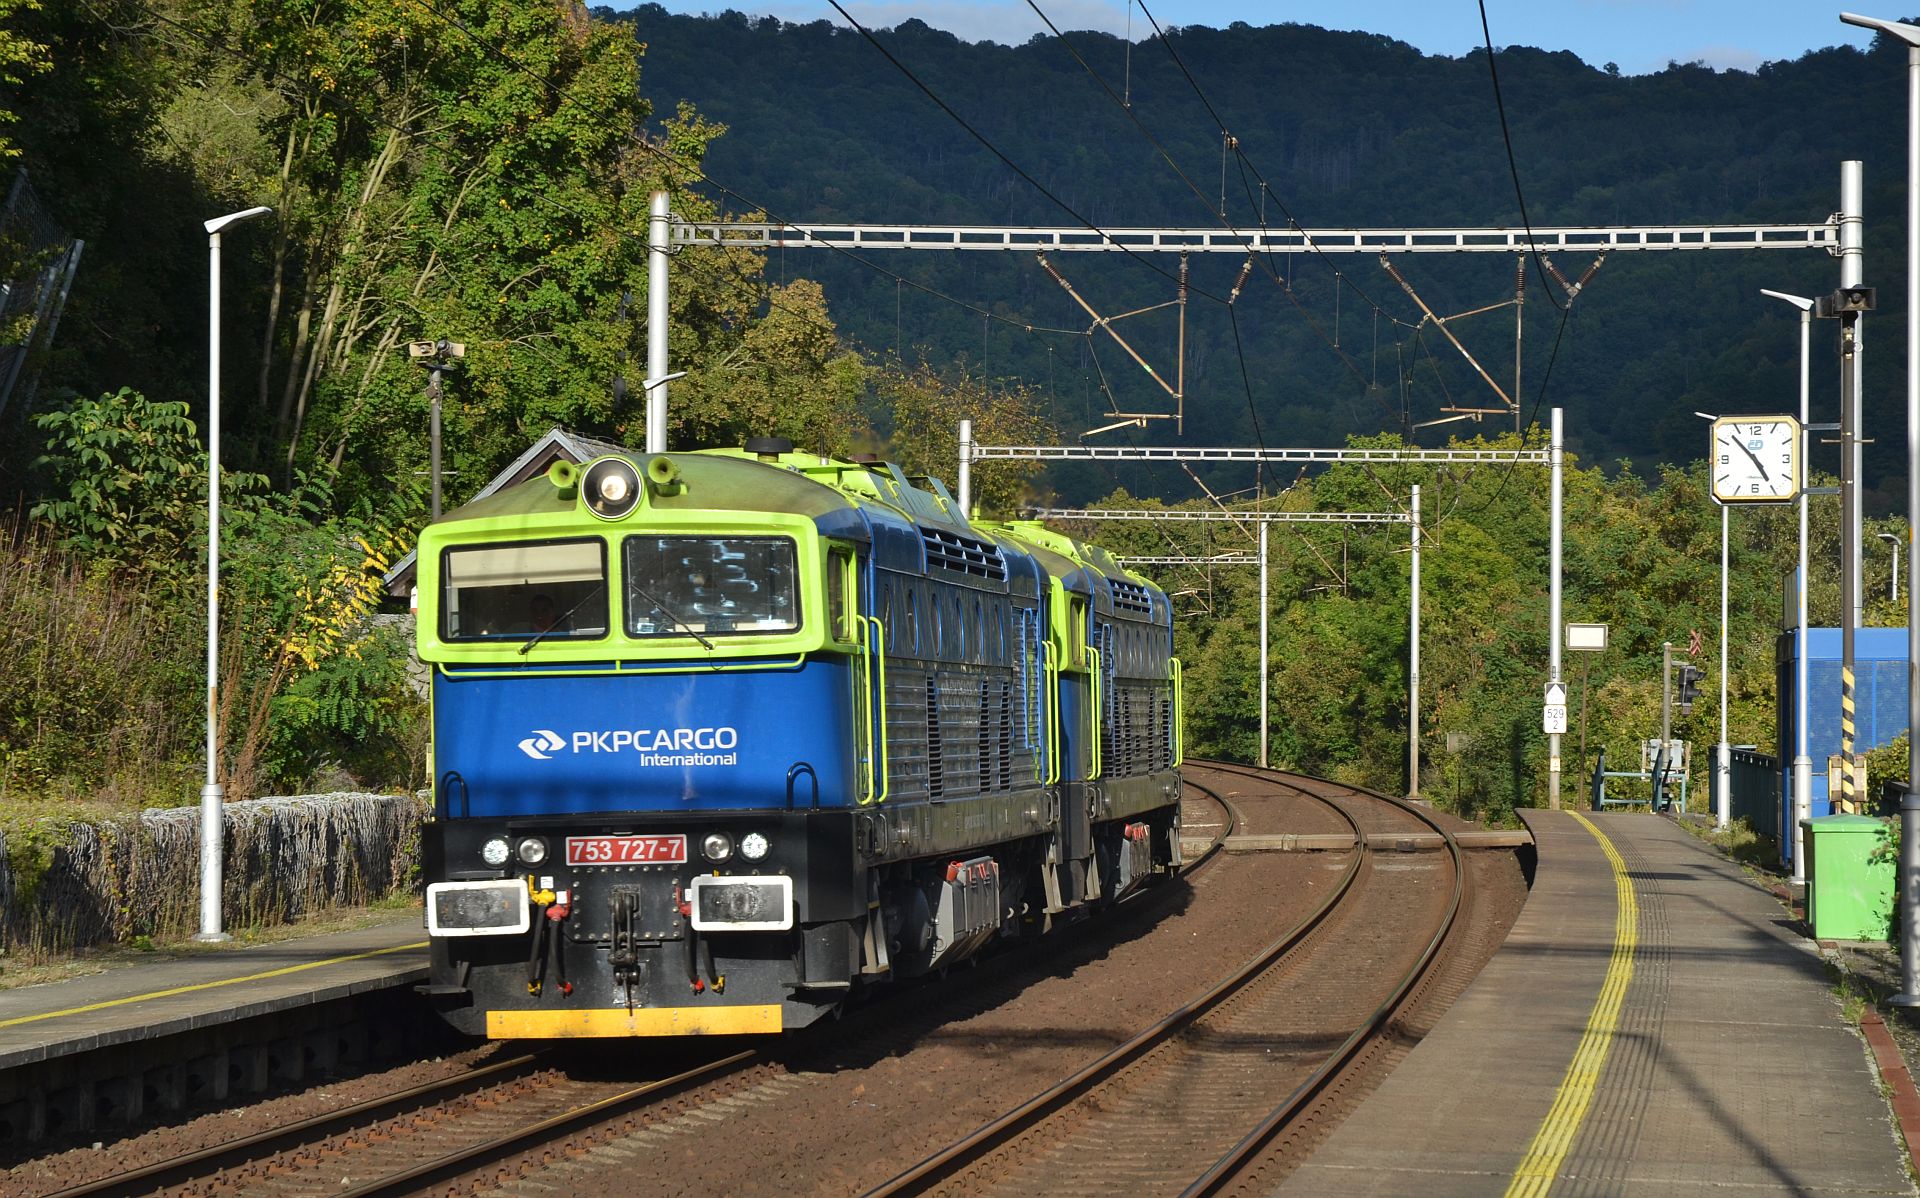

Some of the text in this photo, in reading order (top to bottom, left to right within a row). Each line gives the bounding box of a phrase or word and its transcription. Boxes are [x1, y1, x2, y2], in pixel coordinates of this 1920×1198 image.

[1749, 426, 1762, 436] 12
[1721, 455, 1730, 465] 9
[1782, 454, 1791, 464] 3
[1751, 484, 1760, 494] 6
[1547, 708, 1564, 719] 529
[1553, 720, 1558, 730] 2
[572, 727, 738, 753] PKPCARGO
[640, 752, 737, 767] International
[571, 839, 681, 861] 753 727-7
